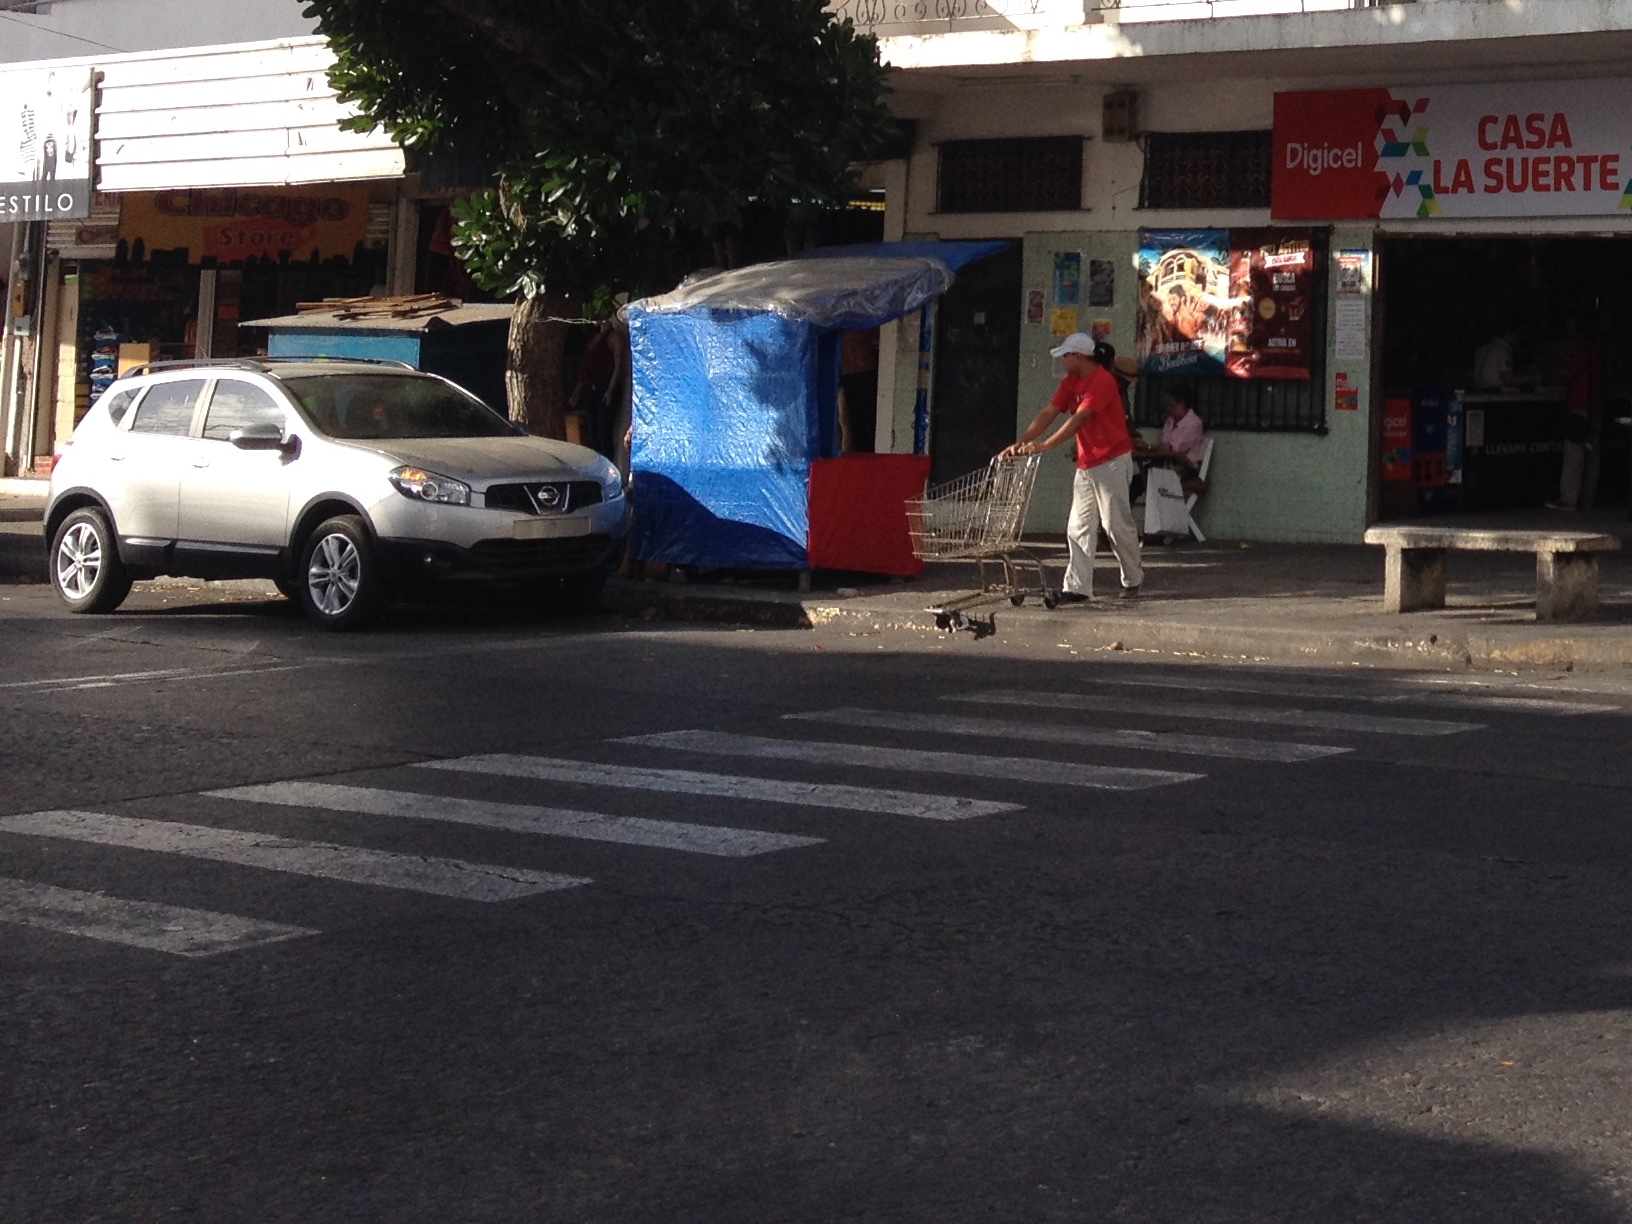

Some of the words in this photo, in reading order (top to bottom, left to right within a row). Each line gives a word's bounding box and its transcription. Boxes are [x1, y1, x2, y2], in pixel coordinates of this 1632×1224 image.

[1477, 112, 1573, 151] CASA
[1286, 142, 1362, 175] Digicel
[1433, 158, 1475, 195] LA
[1483, 154, 1620, 194] SUERTE
[0, 193, 73, 214] ESTILO
[154, 188, 350, 226] Chicago
[218, 227, 296, 248] Store
